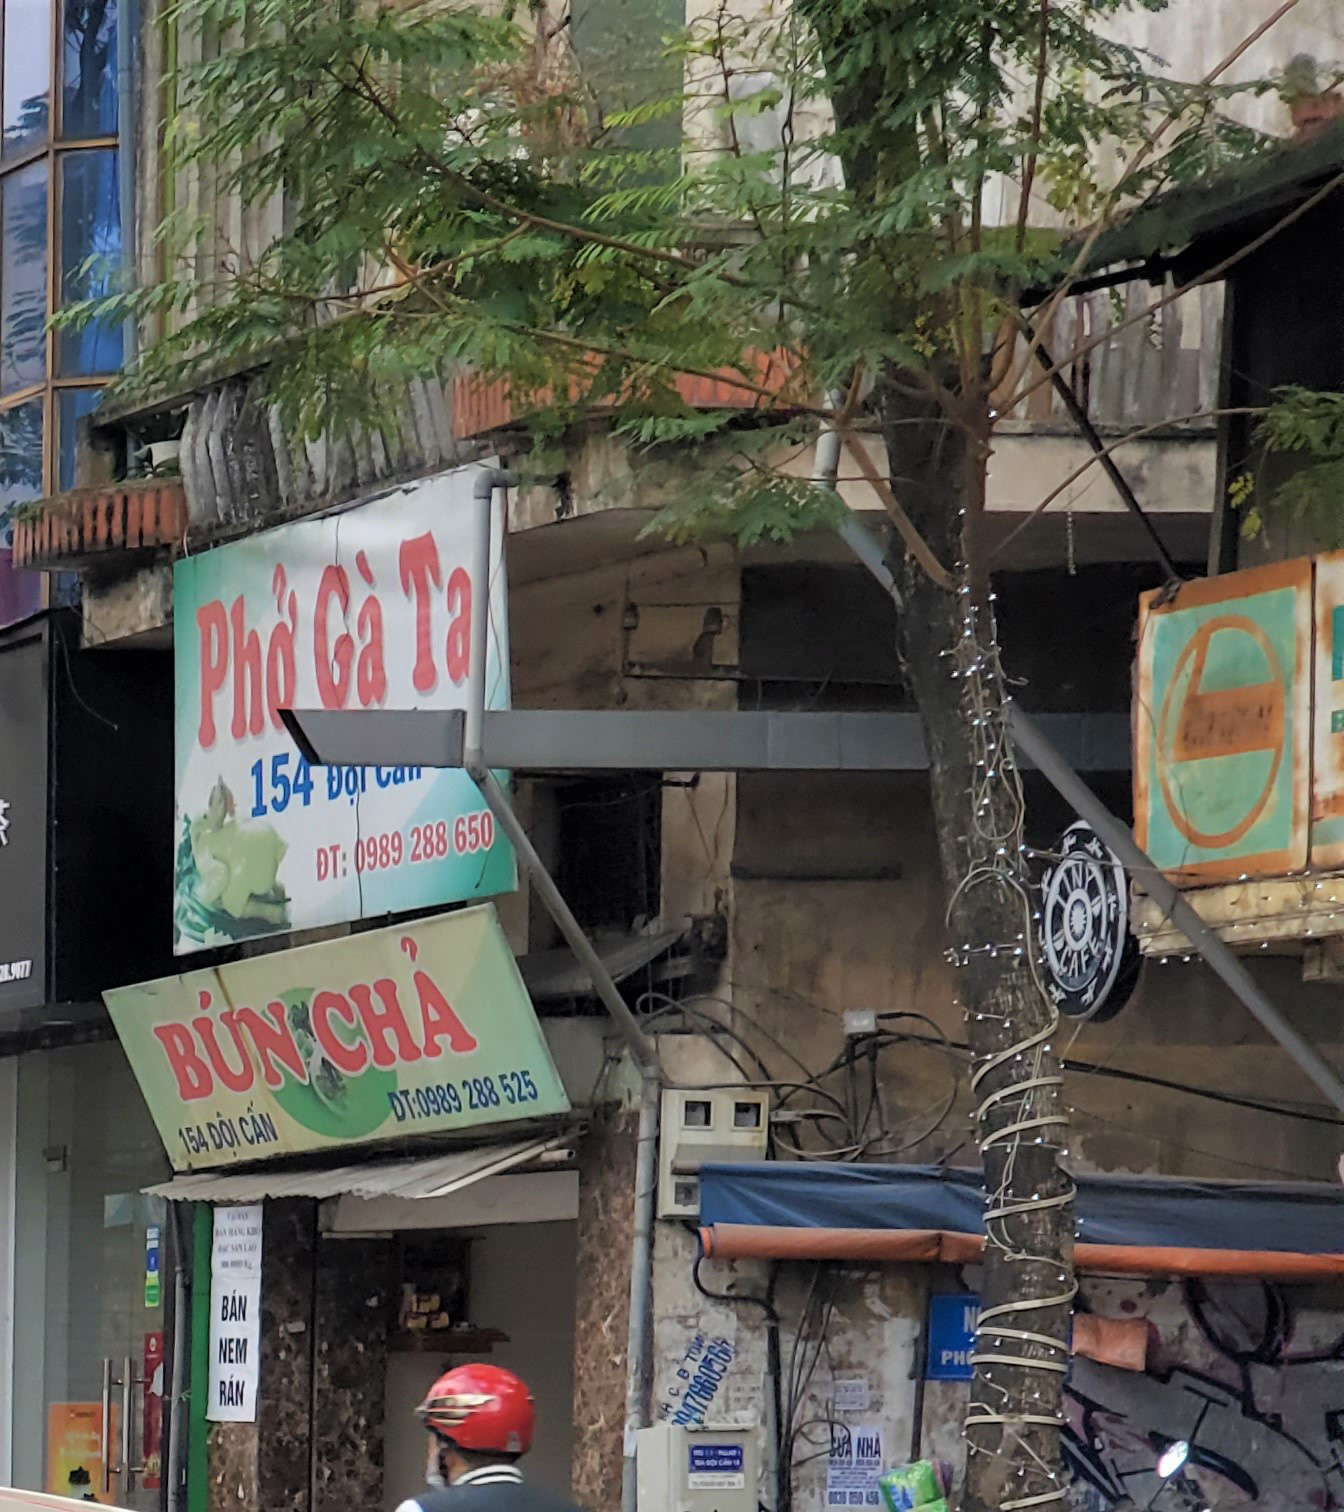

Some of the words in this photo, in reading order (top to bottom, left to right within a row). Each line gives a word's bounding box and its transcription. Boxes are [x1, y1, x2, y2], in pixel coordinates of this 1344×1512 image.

[196, 563, 298, 749] Phở
[314, 549, 387, 710] Gà
[399, 531, 473, 693] Ta
[250, 752, 315, 818] 154
[316, 844, 348, 882] ĐT:
[355, 835, 404, 874] 0989
[410, 822, 448, 862] 288
[454, 809, 496, 853] 650
[154, 991, 309, 1101] BÚN
[311, 936, 478, 1073] CHẢ
[462, 1075, 497, 1111] 288
[499, 1069, 539, 1106] 525
[178, 1126, 210, 1155] 154
[209, 1110, 239, 1158] ĐỘI
[240, 1101, 279, 1144] CẤN
[221, 1289, 248, 1322] BÁN
[218, 1337, 248, 1364] NEM
[219, 1374, 245, 1407] RÁN
